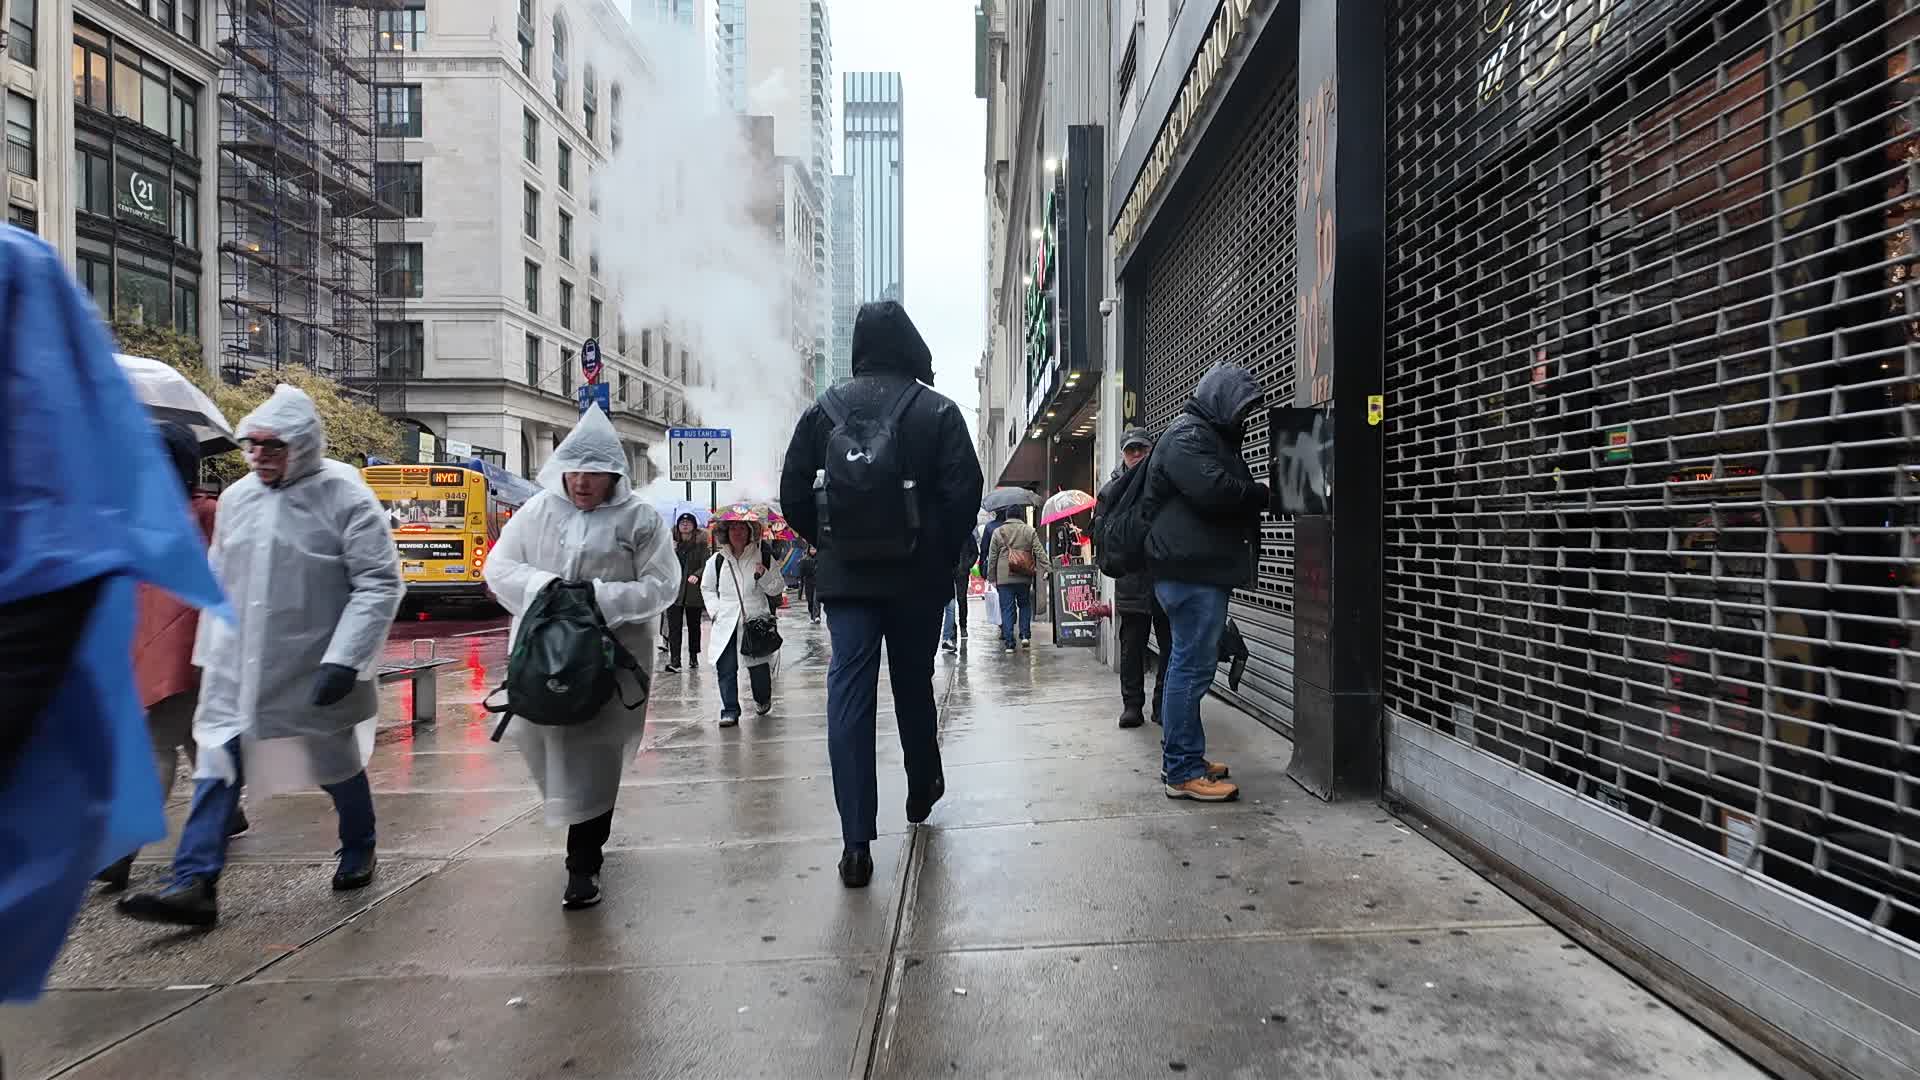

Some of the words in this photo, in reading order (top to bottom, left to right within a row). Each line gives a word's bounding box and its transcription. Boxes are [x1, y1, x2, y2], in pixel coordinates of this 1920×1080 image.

[1315, 201, 1334, 288] to
[684, 430, 697, 438] BUS
[697, 430, 717, 438] LANES
[445, 492, 467, 500] 9449
